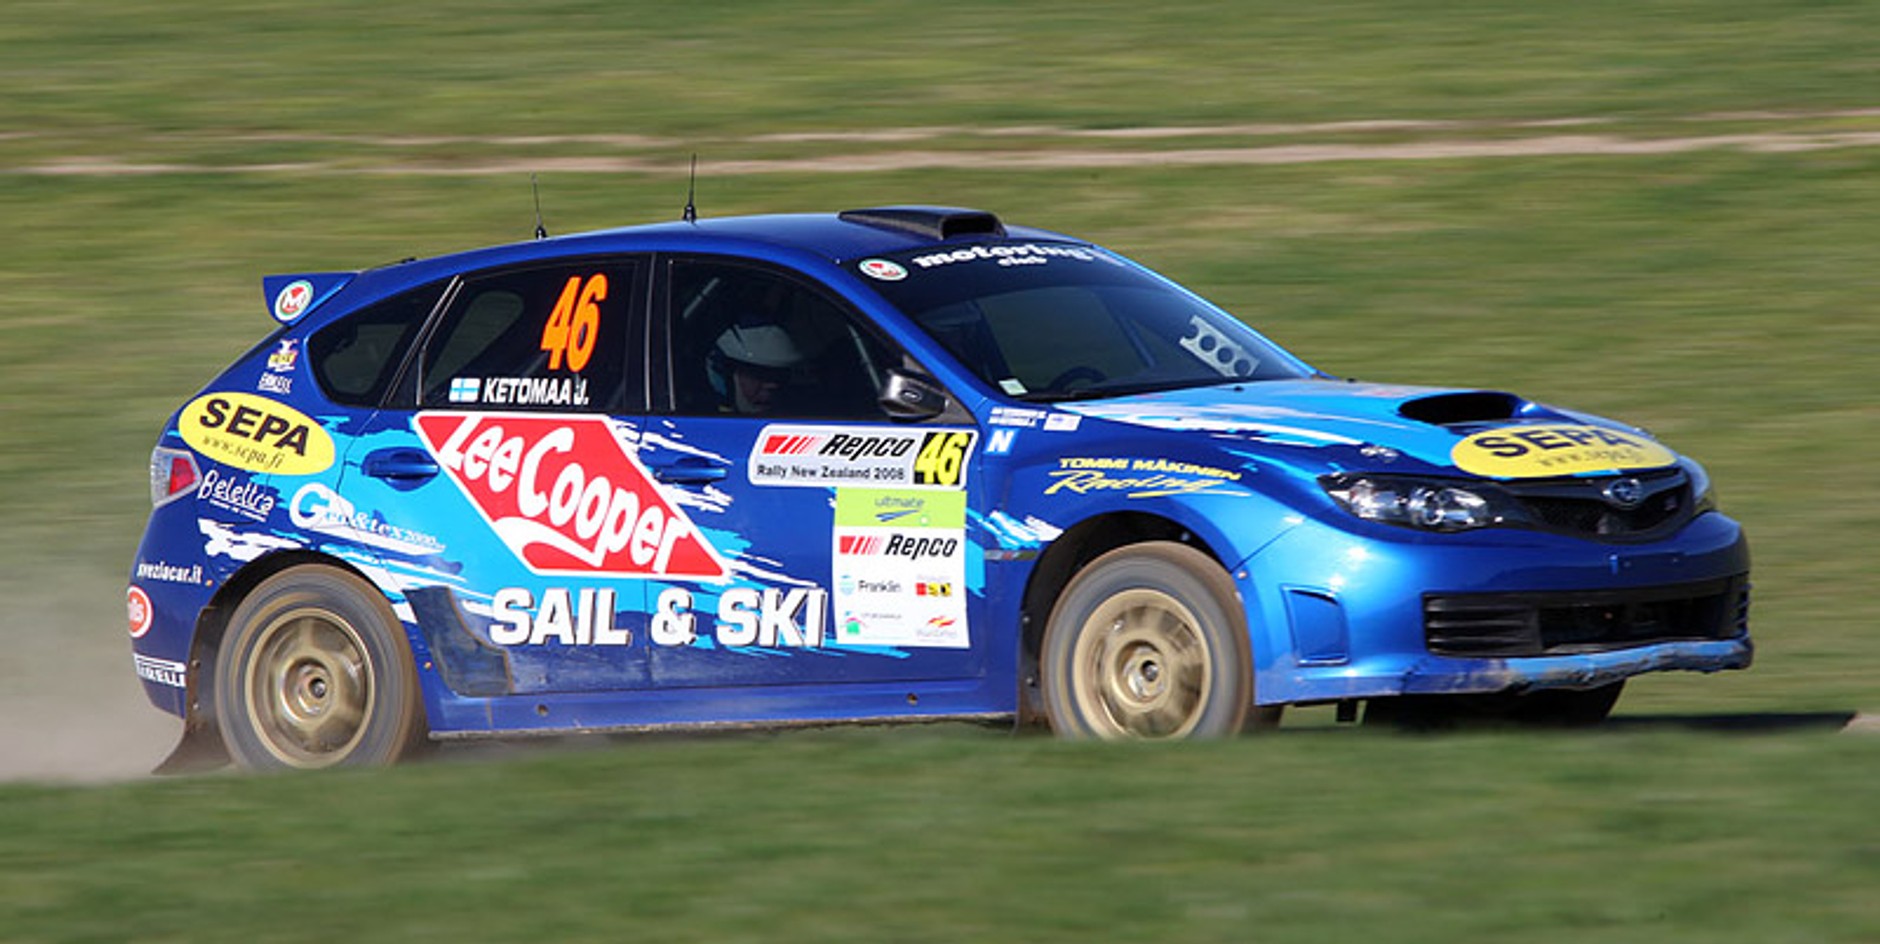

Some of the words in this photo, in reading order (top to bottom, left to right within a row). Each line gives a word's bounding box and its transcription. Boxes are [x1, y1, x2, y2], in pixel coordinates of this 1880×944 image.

[912, 244, 1094, 268] motoring
[540, 273, 608, 373] 46
[482, 377, 572, 405] KETOMAA
[199, 397, 310, 457] SEPA
[987, 429, 1015, 453] N
[1473, 428, 1643, 458] SEPA
[756, 464, 787, 479] Rally
[791, 465, 817, 478] New
[820, 466, 871, 480] Zealand
[874, 467, 906, 481] 2008
[818, 433, 916, 462] Repco
[914, 432, 970, 486] 46
[1060, 457, 1130, 470] TOMMI
[437, 416, 524, 493] Lee
[517, 426, 693, 574] Cooper
[883, 534, 958, 560] Repco
[857, 579, 901, 593] Franklin
[489, 586, 632, 648] SAIL
[650, 587, 698, 647] &
[716, 587, 828, 649] SKI
